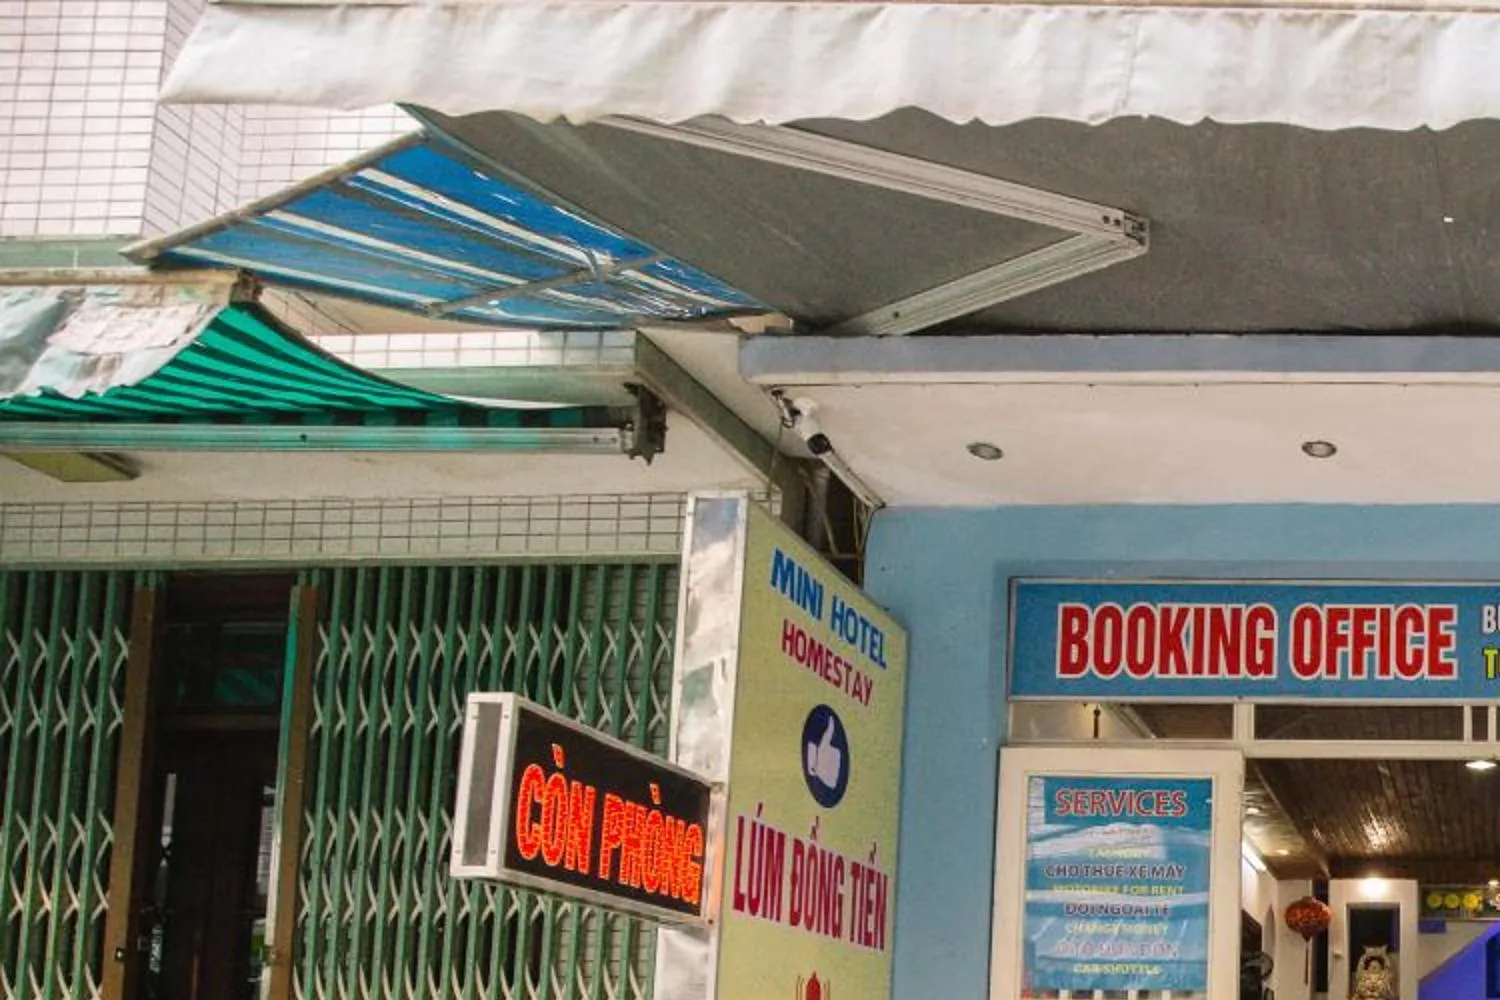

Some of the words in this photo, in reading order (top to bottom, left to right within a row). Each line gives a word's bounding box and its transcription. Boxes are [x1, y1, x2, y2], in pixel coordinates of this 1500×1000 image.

[769, 547, 824, 621] MINI
[830, 594, 888, 670] HOTEL
[1057, 603, 1278, 679] BOOKING
[1289, 603, 1459, 680] OFFICE
[781, 618, 874, 708] HOMESTAY
[516, 743, 597, 875] CÒN
[599, 782, 703, 905] PHÒNG
[1054, 789, 1188, 818] SERVICES
[733, 801, 787, 923] LÚM
